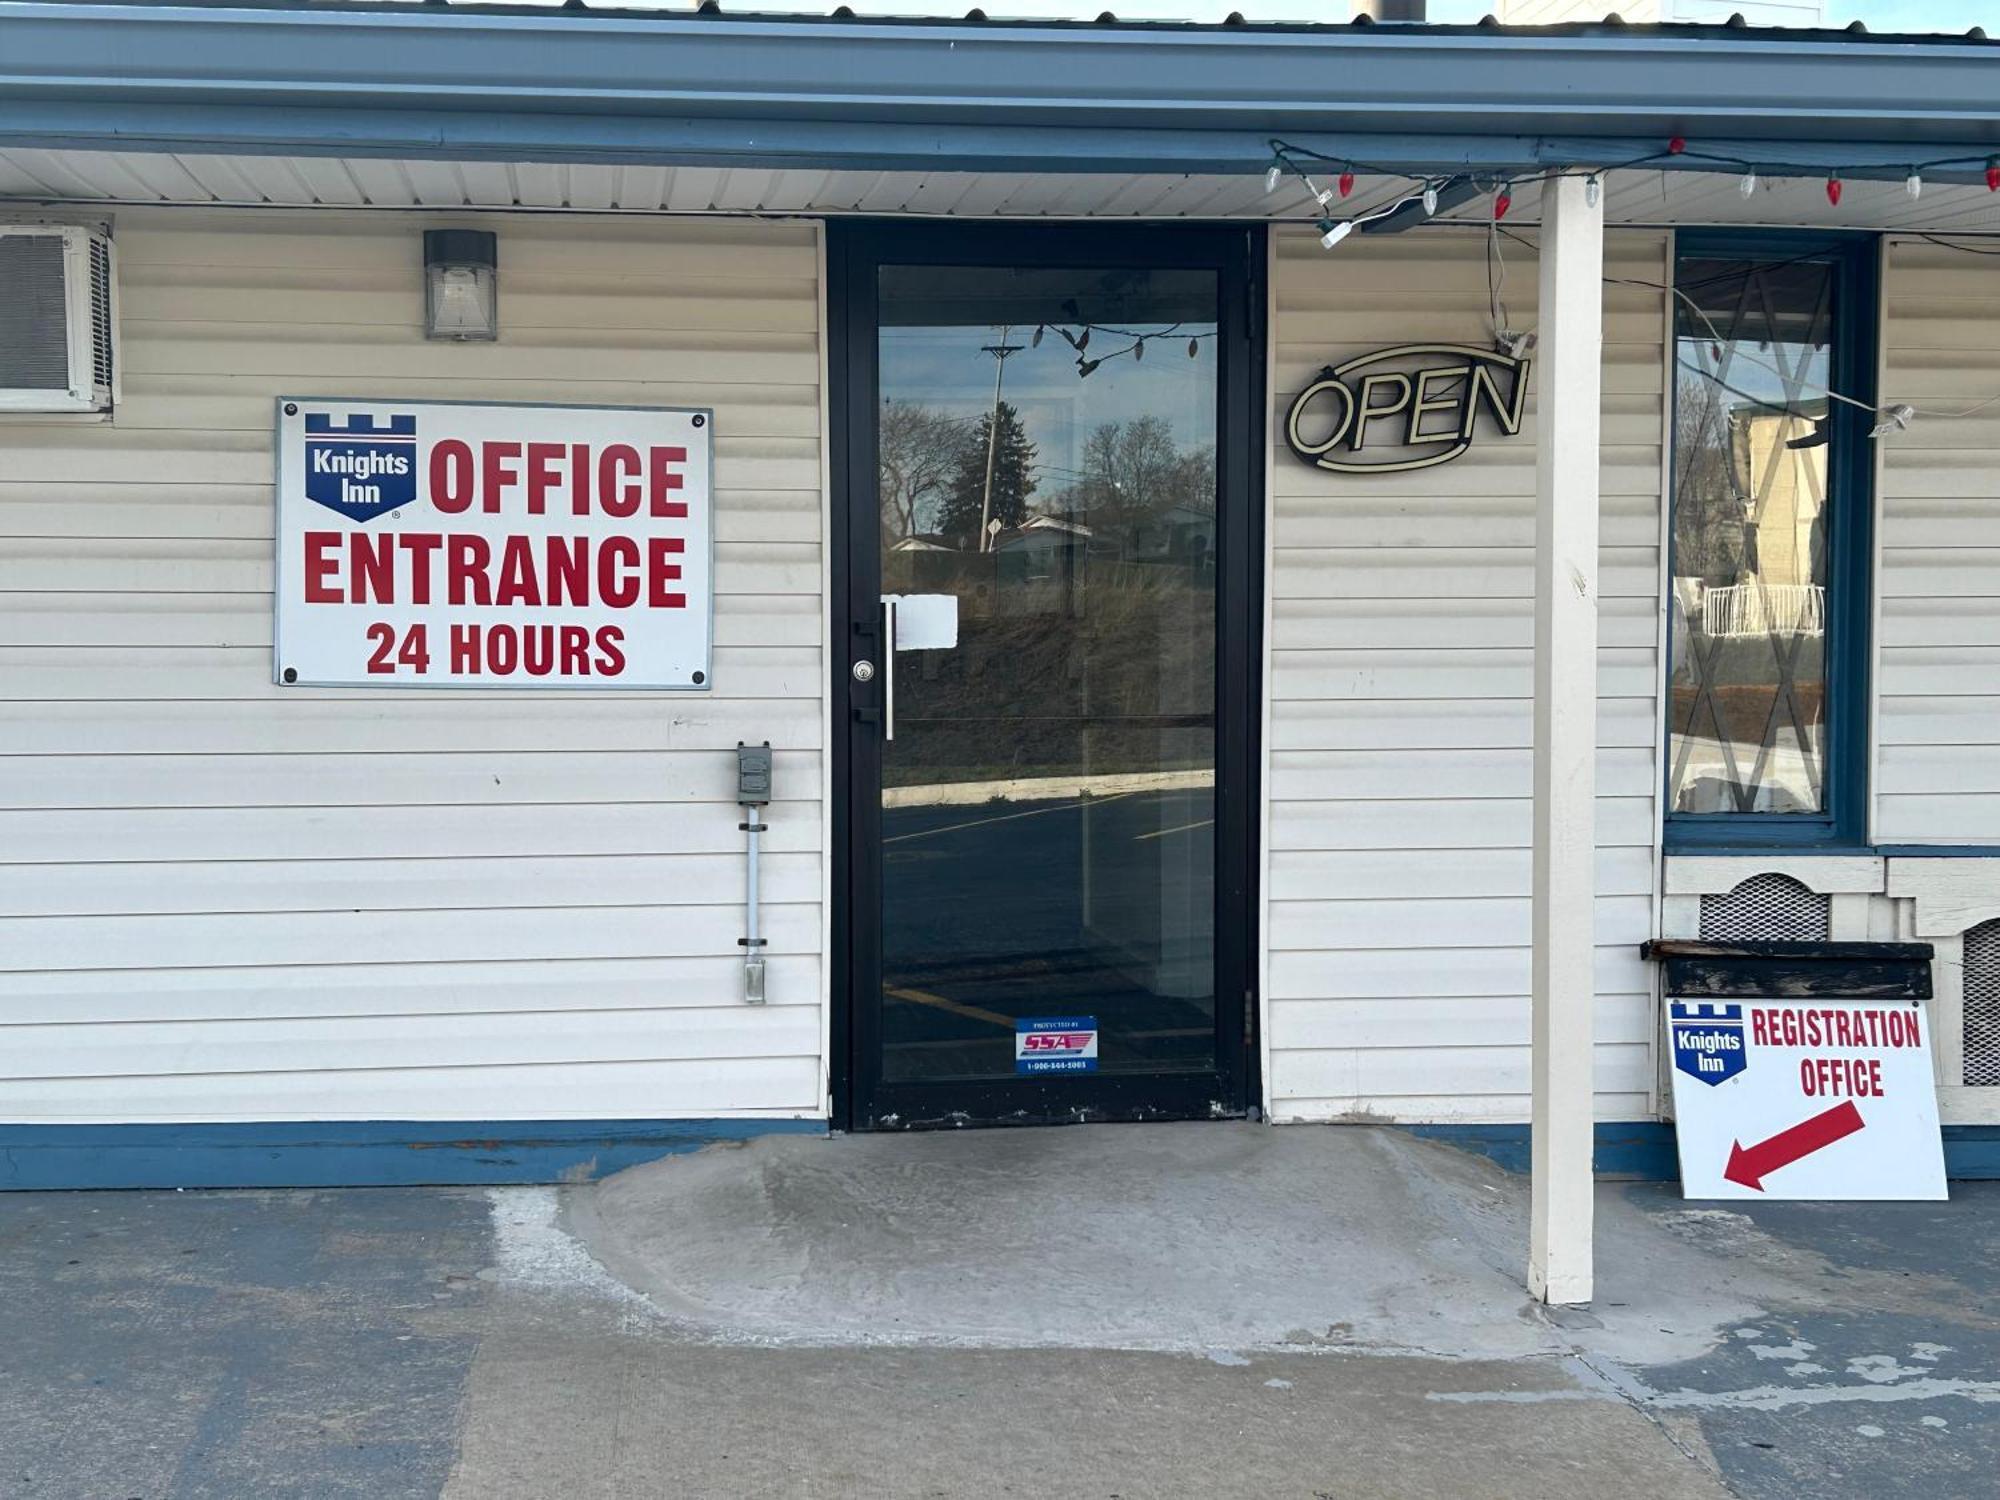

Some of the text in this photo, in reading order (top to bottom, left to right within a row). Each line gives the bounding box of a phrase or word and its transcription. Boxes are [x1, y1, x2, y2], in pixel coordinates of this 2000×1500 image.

[1284, 359, 1531, 459] OPEN
[314, 448, 409, 481] Knights
[429, 439, 689, 518] OFFICE
[341, 478, 380, 503] Inn
[304, 531, 687, 609] ENTRANCE
[366, 622, 627, 677] 24 HOURS
[1024, 1033, 1072, 1050] SSA
[1677, 1030, 1741, 1054] Knights
[1751, 1008, 1921, 1048] REGISTRATION
[1697, 1053, 1724, 1073] Inn
[1800, 1058, 1885, 1097] OFFICE
